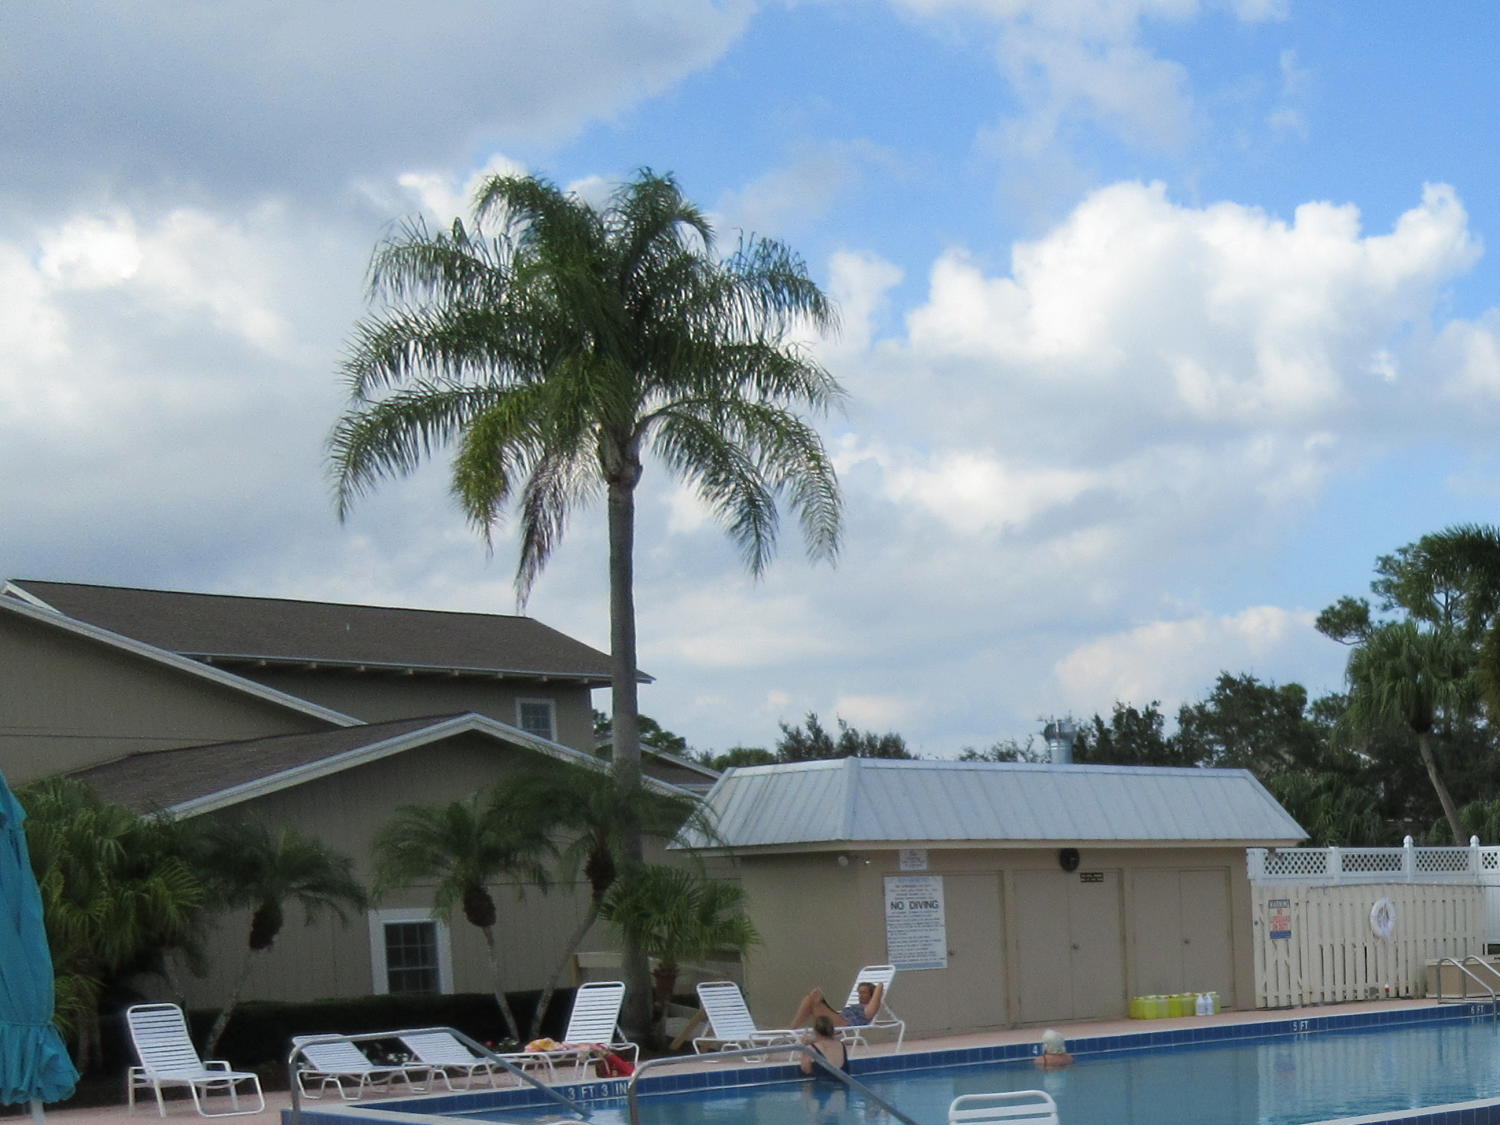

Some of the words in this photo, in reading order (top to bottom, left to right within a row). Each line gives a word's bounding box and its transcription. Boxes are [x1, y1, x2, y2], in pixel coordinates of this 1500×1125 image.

[890, 901, 904, 910] NO
[909, 900, 939, 910] DIVING
[1300, 1021, 1309, 1030] FT
[1032, 1045, 1038, 1055] 4
[568, 1087, 575, 1100] 3
[581, 1086, 595, 1098] FT
[601, 1084, 608, 1096] 3
[615, 1082, 627, 1095] IN
